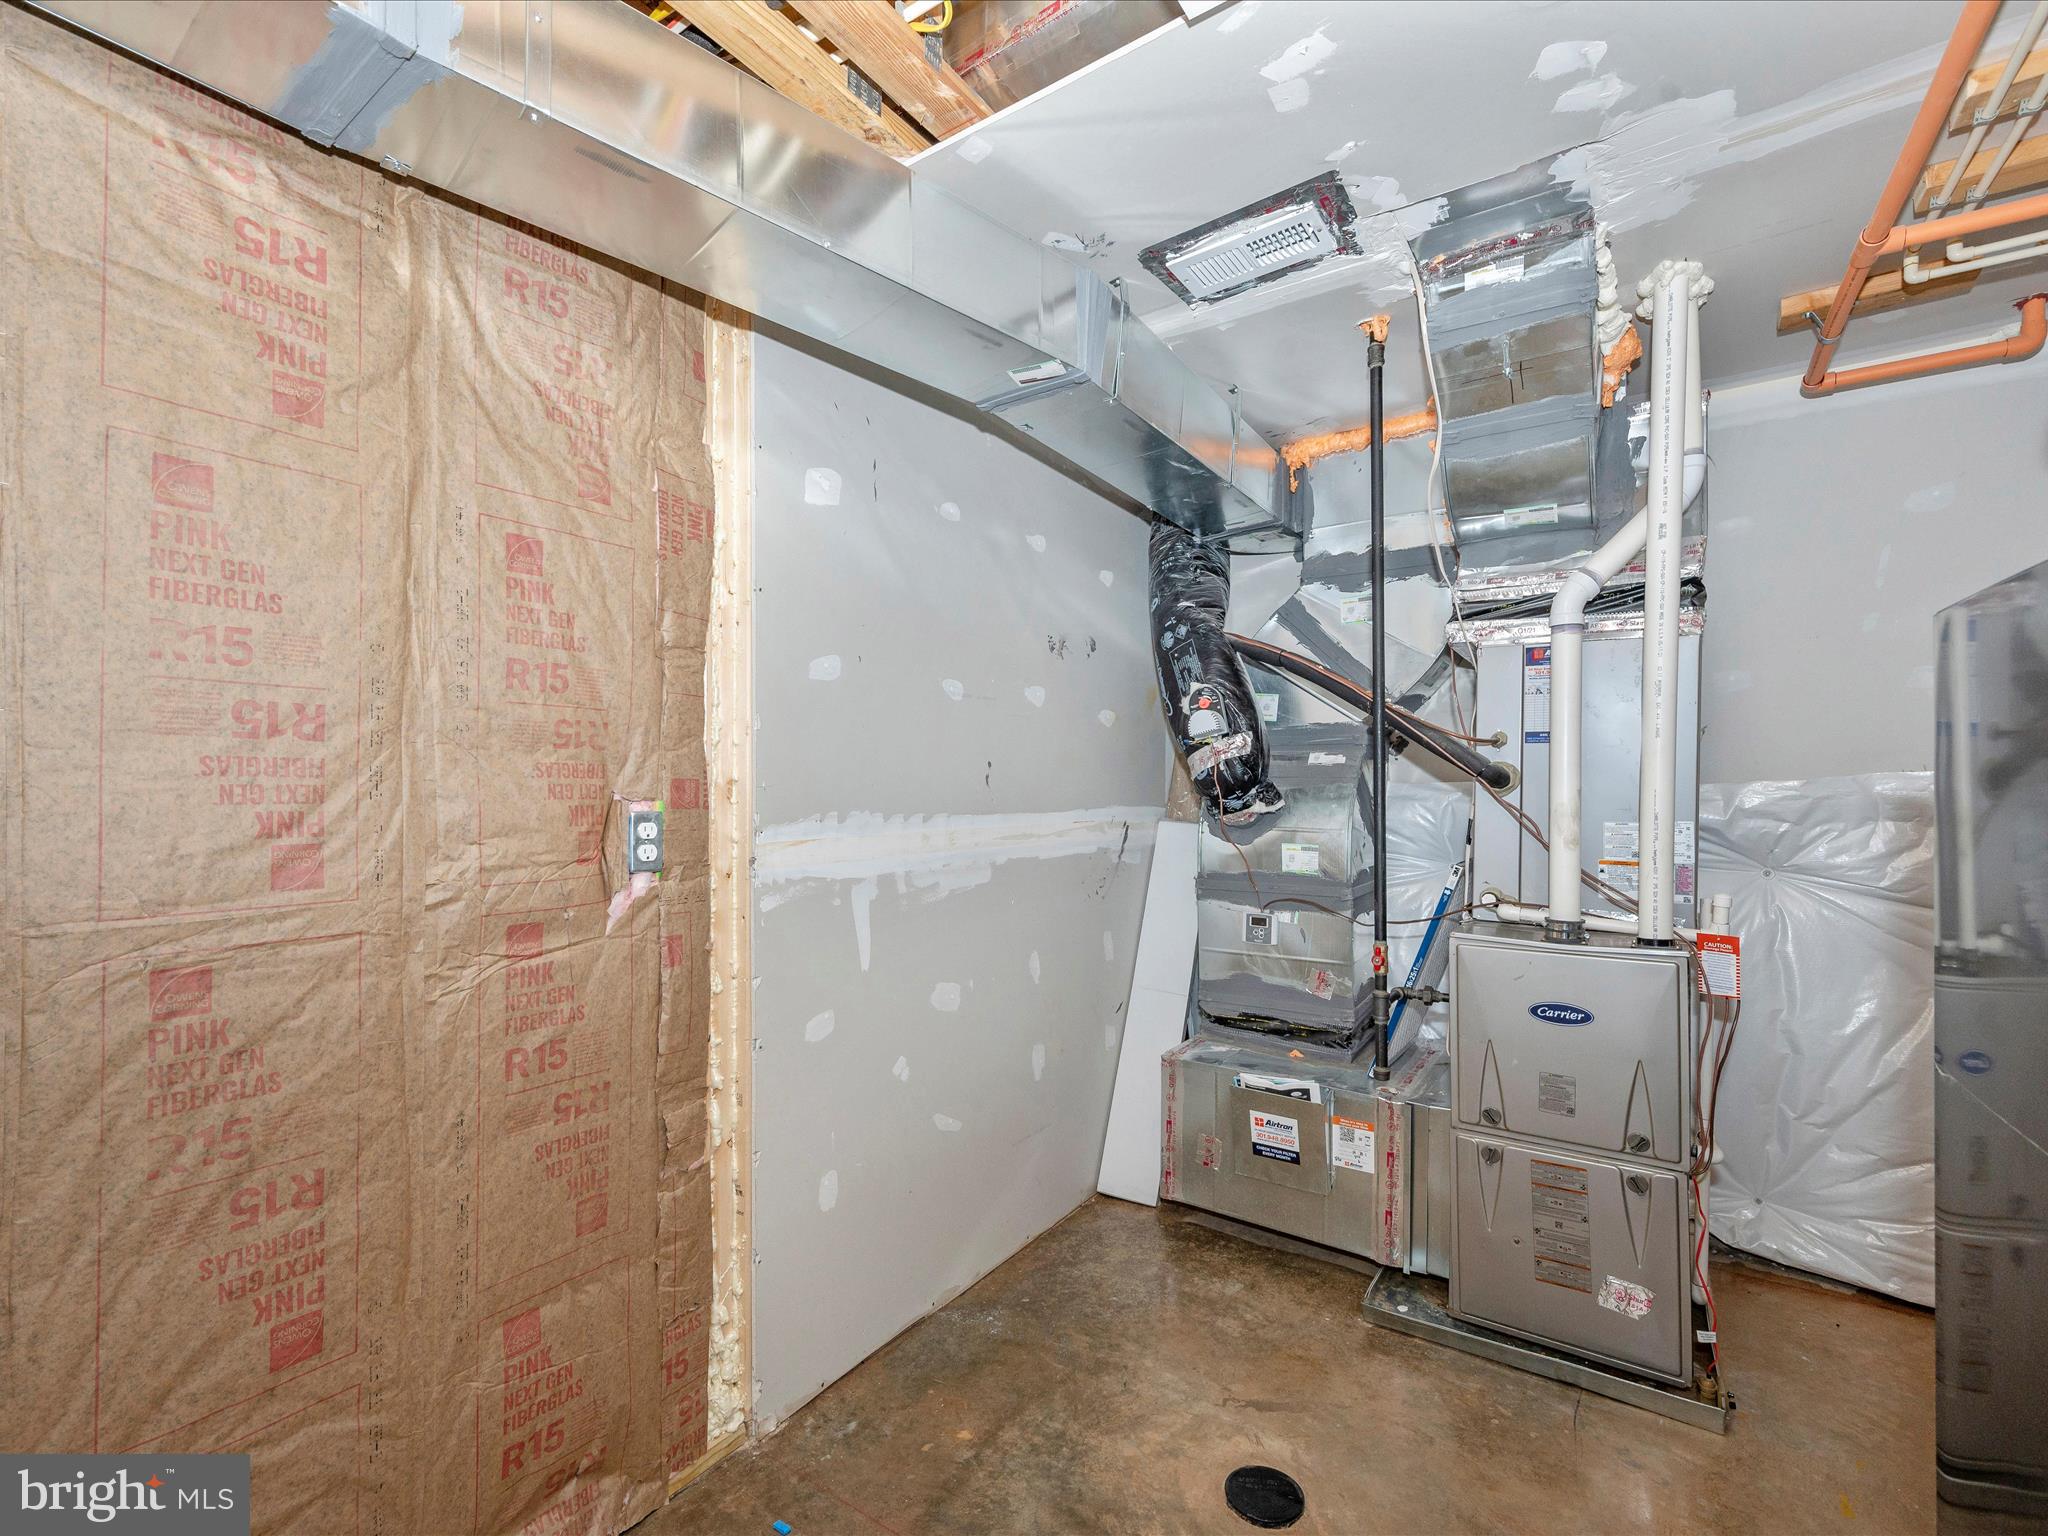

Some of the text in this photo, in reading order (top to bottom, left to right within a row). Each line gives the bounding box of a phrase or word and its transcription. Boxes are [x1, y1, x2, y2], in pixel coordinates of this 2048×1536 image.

[233, 215, 328, 285] R15
[505, 233, 590, 286] FIBERGLAS
[203, 256, 328, 320] FIBERGLAS
[503, 264, 570, 320] R15
[221, 291, 328, 346] NEXT GEN
[256, 330, 327, 379] PINK
[150, 510, 232, 552] PINK
[149, 547, 265, 585] NEXT GEN
[148, 575, 283, 615] FIBERGLAS
[506, 576, 555, 606] PINK
[506, 603, 576, 631] NEXT GEN
[506, 626, 586, 654] FIBERGLAS
[505, 657, 570, 695] R15
[231, 699, 327, 742] R15
[200, 754, 327, 779] FIBERGLAS
[535, 762, 608, 779] FIBERGLAS
[218, 783, 327, 806] NEXT GEN
[547, 783, 574, 801] GEN
[254, 810, 325, 840] PINK
[1451, 866, 1460, 878] 3M
[505, 961, 555, 990] PINK
[505, 984, 576, 1013] NEXT GEN
[1537, 1006, 1585, 1021] Carrier
[148, 1017, 231, 1064] PINK
[504, 1004, 585, 1038] FIBERGLAS
[147, 1045, 265, 1091] NEXT GEN
[505, 1037, 568, 1083] R15
[147, 1071, 283, 1121] FIBERGLAS
[553, 1081, 611, 1126] R15
[534, 1123, 611, 1162] FIBERGLAS
[1265, 1119, 1294, 1131] Airtron
[545, 1144, 610, 1181] NEXT GEN
[566, 1166, 610, 1201] PINK
[229, 1168, 326, 1232] R15
[198, 1220, 326, 1282] FIBERGLAS
[218, 1248, 326, 1306] NEXT GEN
[253, 1275, 326, 1328] PINK
[503, 1344, 552, 1389] PINK
[503, 1379, 584, 1436] FIBERGLAS
[504, 1362, 574, 1414] NEXT GEN
[501, 1416, 566, 1481] R15
